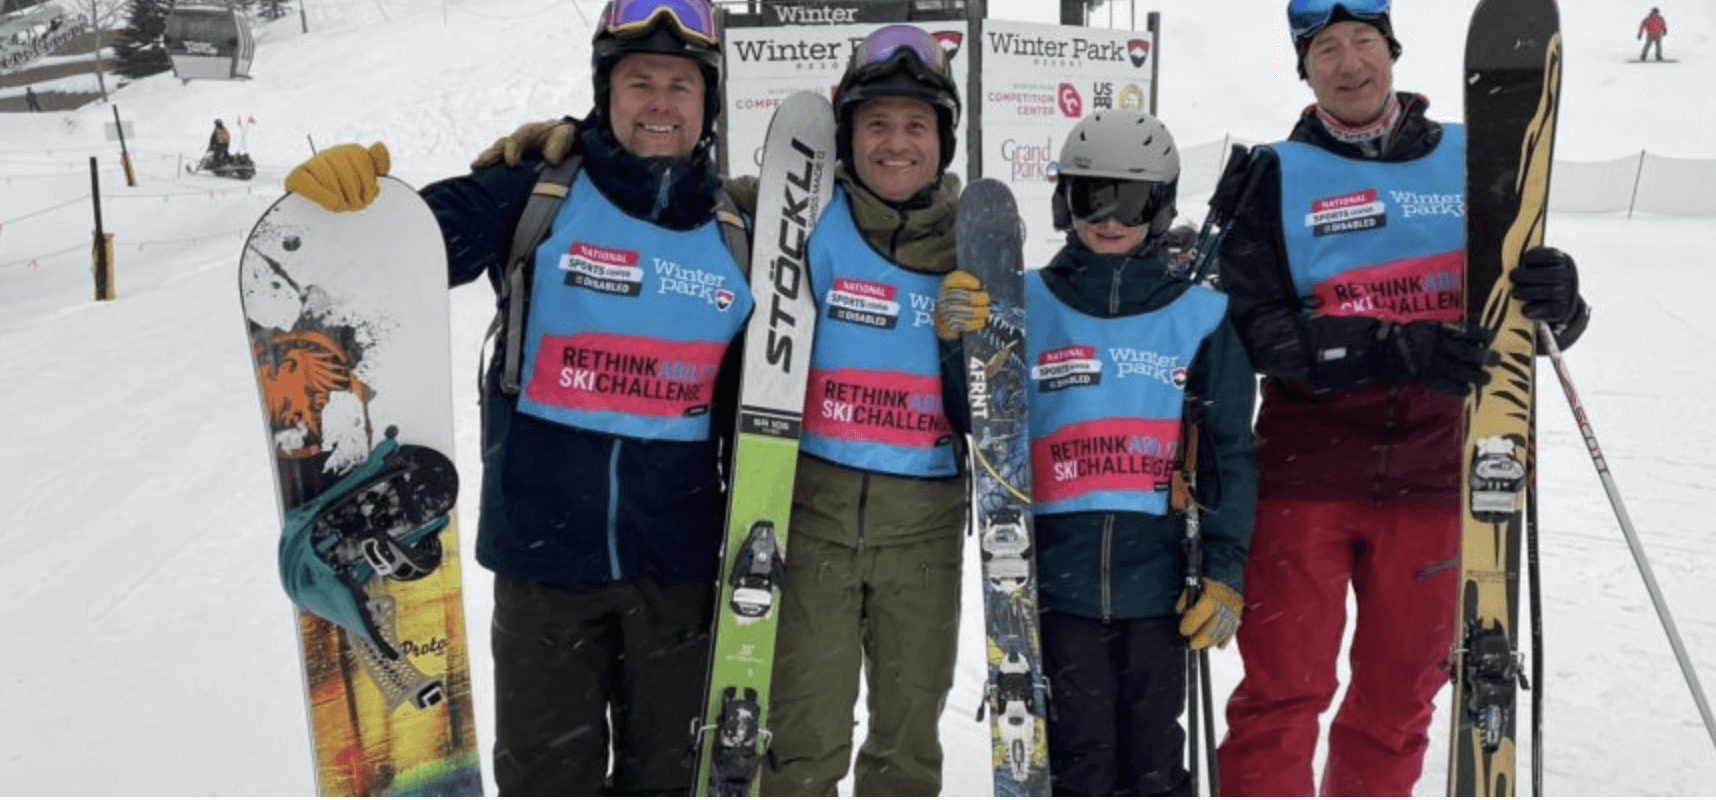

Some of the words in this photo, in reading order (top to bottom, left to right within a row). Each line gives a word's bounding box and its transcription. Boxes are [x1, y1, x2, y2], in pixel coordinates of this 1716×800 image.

[772, 5, 859, 23] Winter
[733, 39, 842, 62] Winter
[987, 32, 1069, 58] Winter
[1072, 38, 1126, 62] Park
[1001, 135, 1051, 162] Grand
[1320, 194, 1366, 209] NATIONAL
[1388, 189, 1463, 204] Winter
[580, 245, 628, 264] NATIONAL
[568, 257, 605, 276] SPORTS
[653, 257, 726, 288] Winter
[583, 276, 630, 294] DISABLED
[658, 275, 715, 305] park
[843, 280, 886, 297] NATIONAL
[830, 292, 866, 309] SPORTS
[1108, 348, 1179, 368] Winter
[1117, 362, 1172, 384] park
